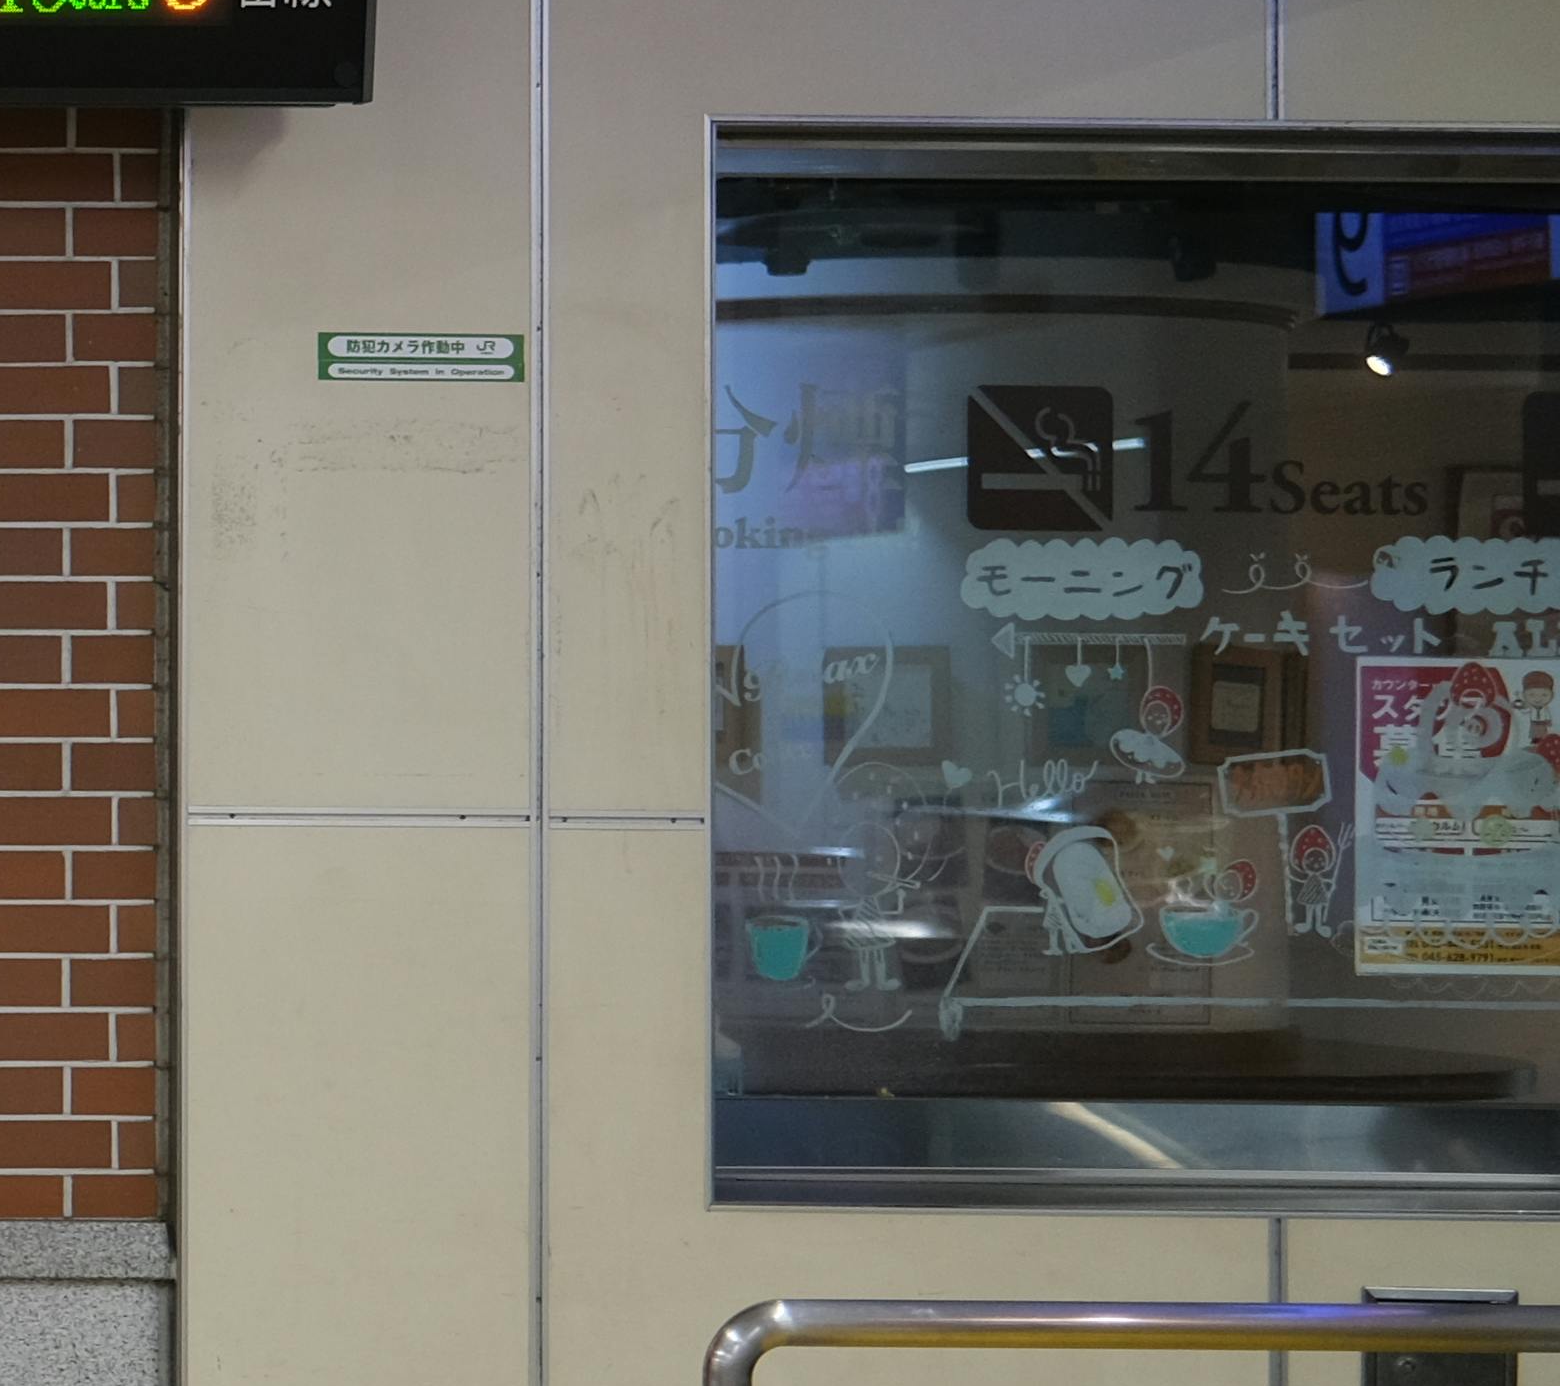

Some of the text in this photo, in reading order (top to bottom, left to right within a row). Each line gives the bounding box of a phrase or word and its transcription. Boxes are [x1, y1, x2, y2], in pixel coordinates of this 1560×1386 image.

[346, 339, 465, 355] 防犯カメラ作動中
[338, 367, 505, 378] Security System Operation
[1134, 401, 1428, 515] 14 Seats
[977, 563, 1192, 600] モーニング
[1430, 558, 1549, 595] ランチ
